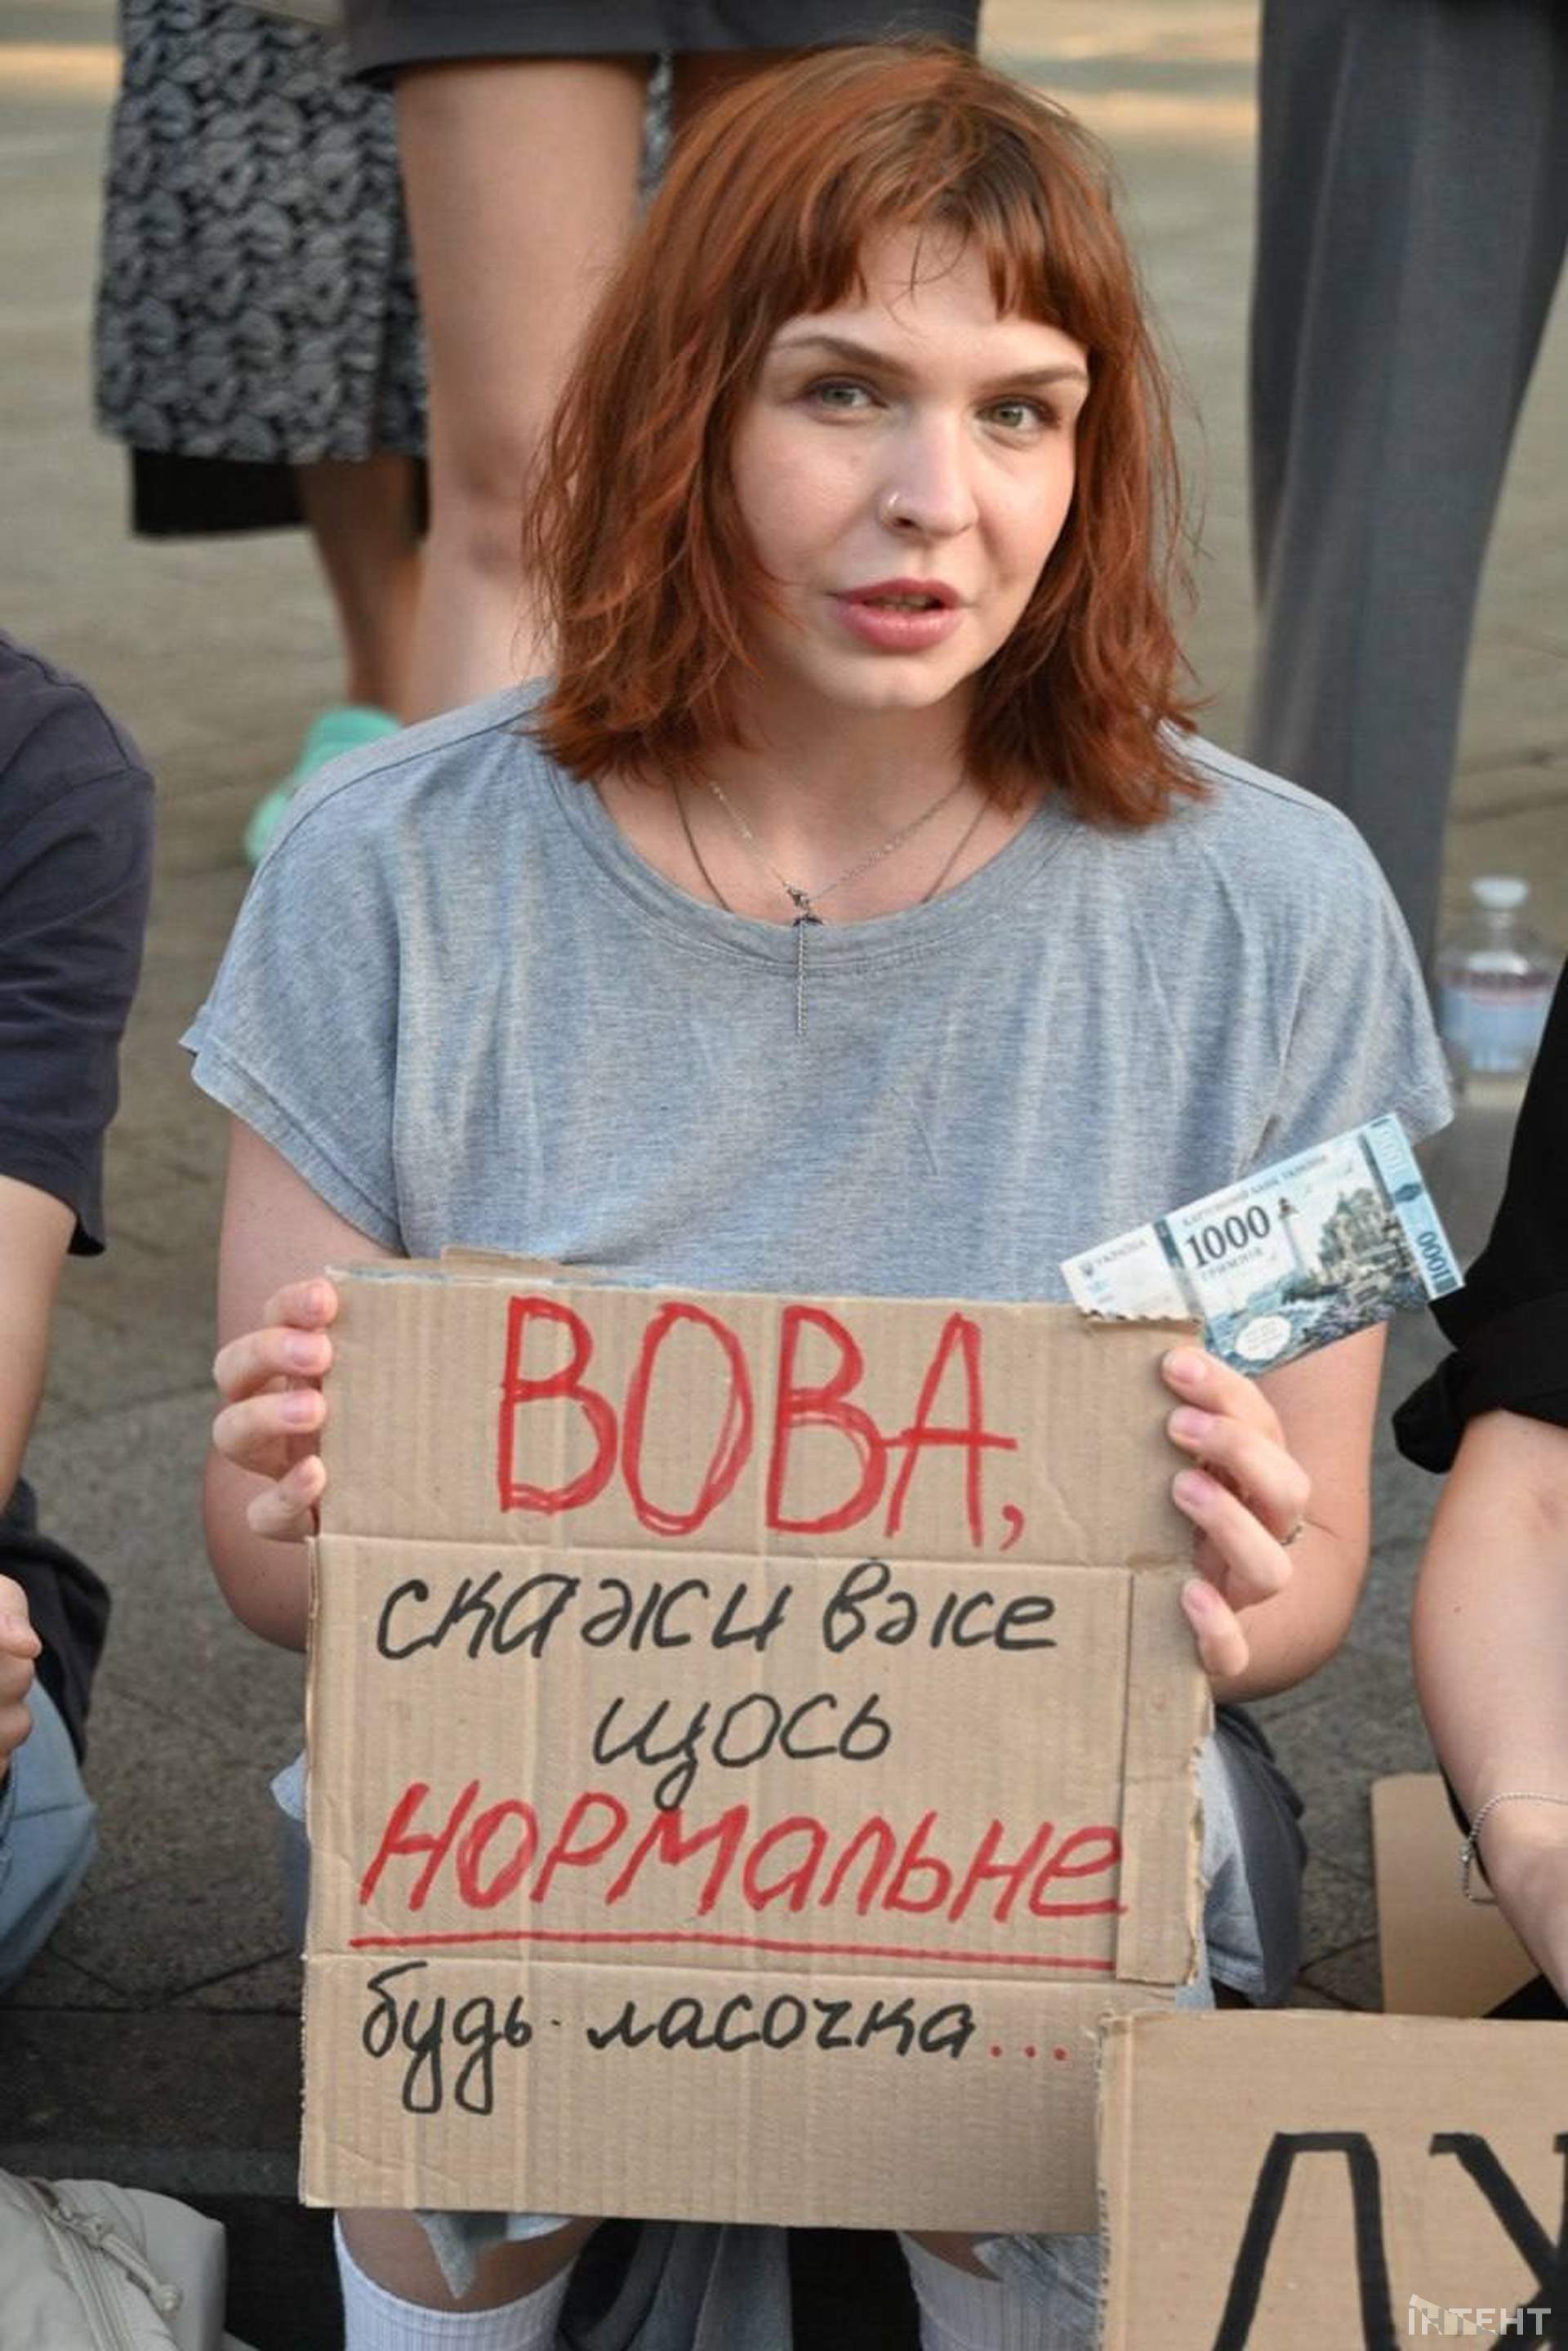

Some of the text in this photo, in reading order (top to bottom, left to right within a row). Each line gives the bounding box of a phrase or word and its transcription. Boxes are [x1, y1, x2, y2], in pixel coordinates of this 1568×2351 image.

[1186, 1204, 1271, 1268] 1000
[497, 1295, 1025, 1550] ВОВА,
[376, 1559, 1056, 1660] скажи вже
[593, 1693, 891, 1812] щось
[362, 1961, 532, 2116] будь
